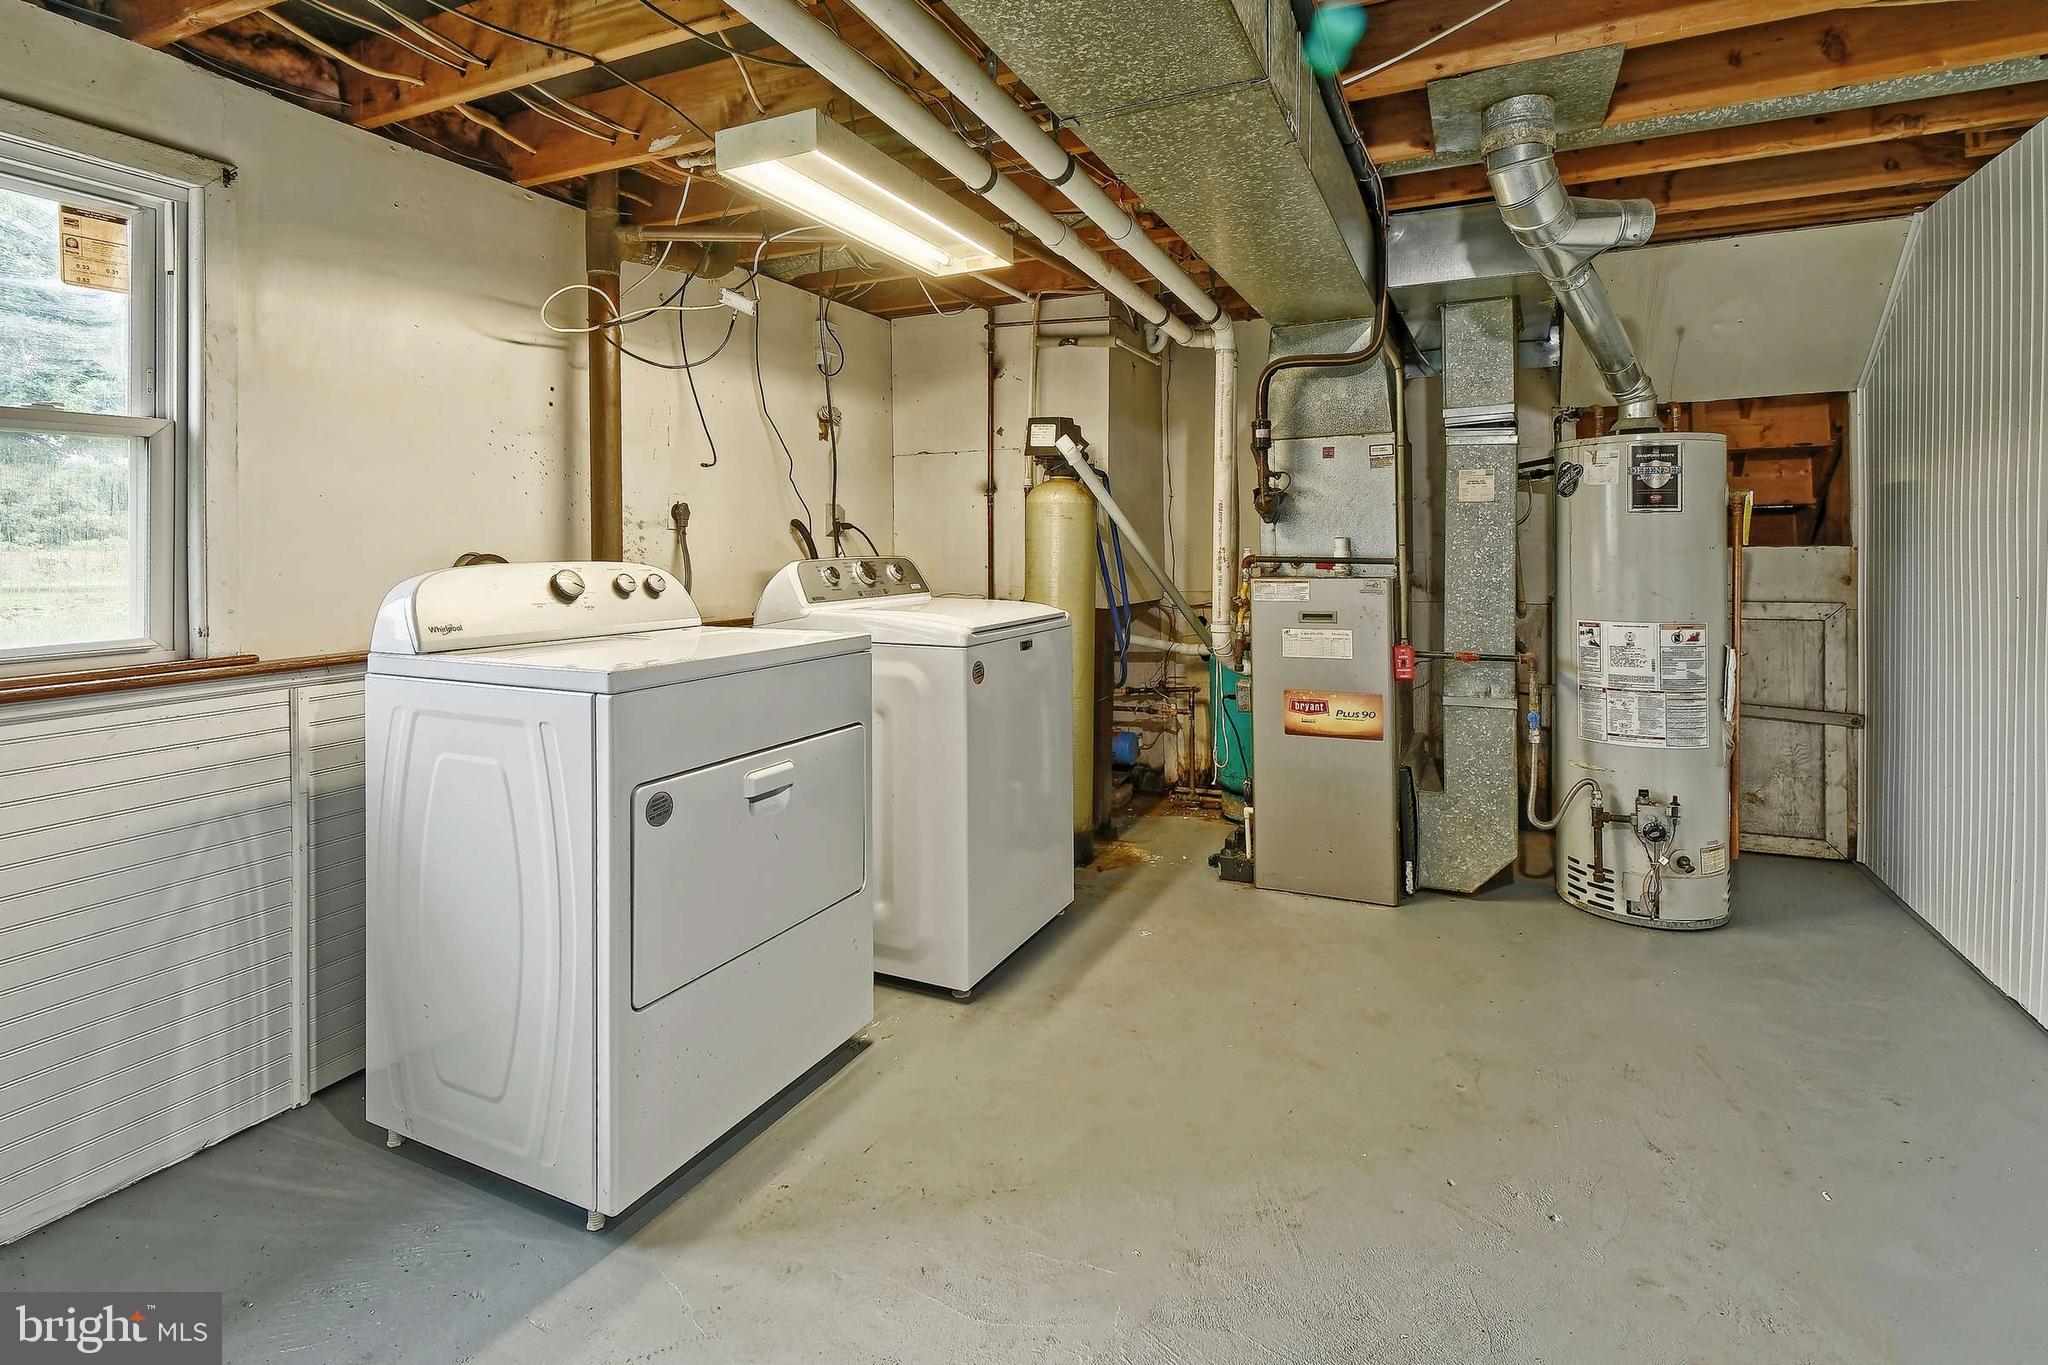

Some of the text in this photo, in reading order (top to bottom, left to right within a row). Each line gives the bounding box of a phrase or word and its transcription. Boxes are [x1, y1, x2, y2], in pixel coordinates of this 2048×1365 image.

[1629, 466, 1681, 475] DEFENDER
[428, 623, 464, 636] Whirlpool
[1294, 701, 1325, 712] bryant
[1361, 710, 1377, 719] 90
